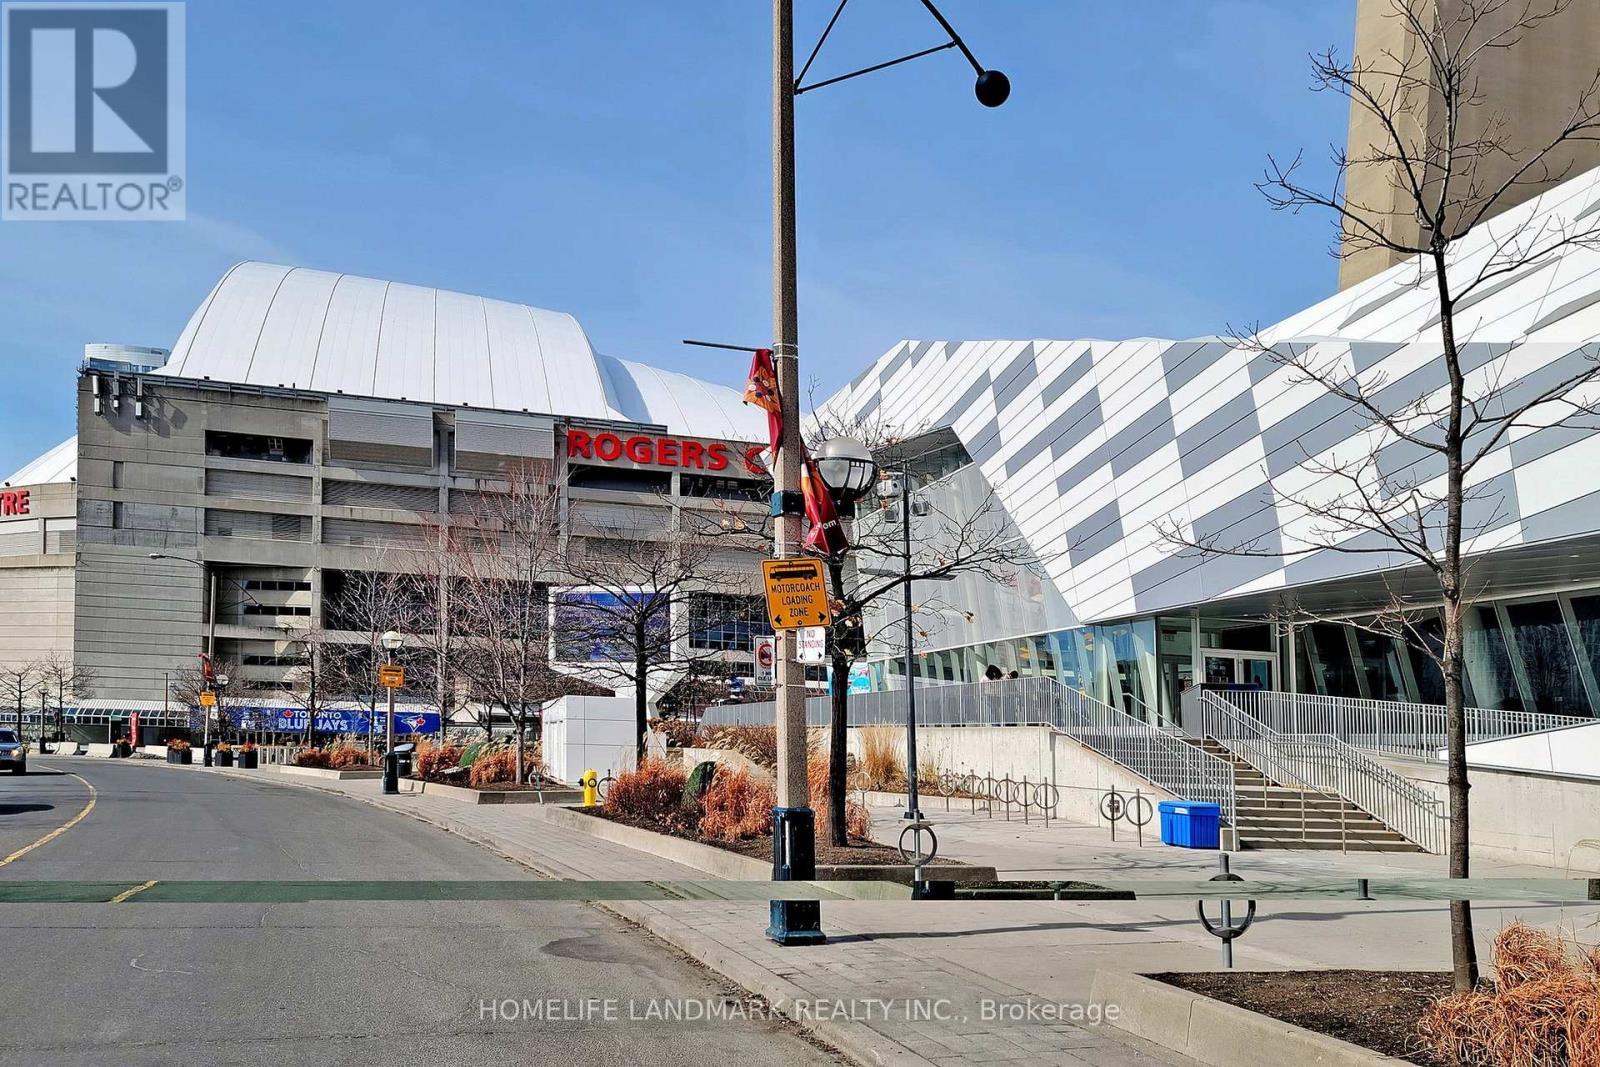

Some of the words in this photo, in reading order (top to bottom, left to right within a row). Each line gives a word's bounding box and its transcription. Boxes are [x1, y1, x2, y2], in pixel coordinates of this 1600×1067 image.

[567, 429, 729, 471] ROGERS
[771, 582, 821, 593] MOTORCOACH
[781, 595, 813, 606] LOADING
[789, 607, 809, 618] ZONE
[806, 629, 816, 638] NO
[798, 639, 824, 649] STANDING
[294, 710, 342, 719] TOONTO
[315, 719, 348, 731] JAYS
